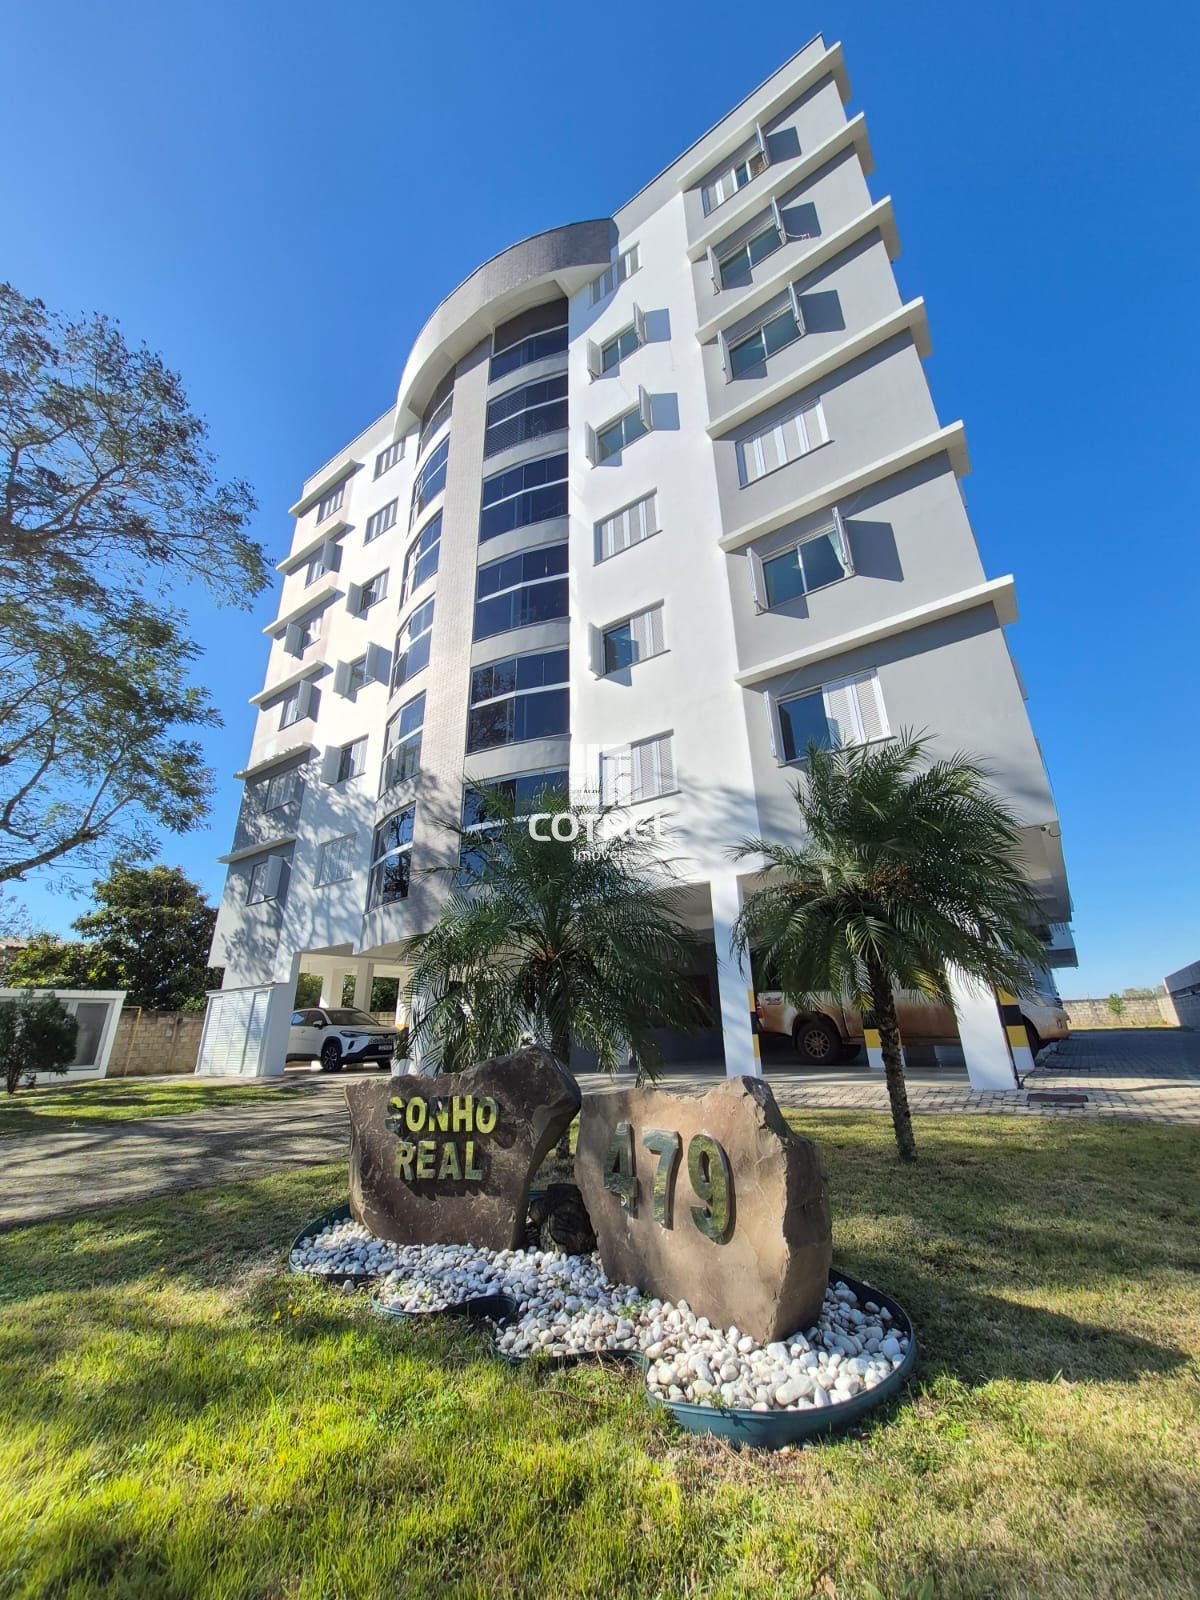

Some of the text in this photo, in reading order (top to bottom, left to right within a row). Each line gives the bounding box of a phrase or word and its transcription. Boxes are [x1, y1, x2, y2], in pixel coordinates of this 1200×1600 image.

[385, 1095, 498, 1134] SONHO
[394, 1140, 484, 1180] REAL
[603, 1120, 735, 1245] 479
